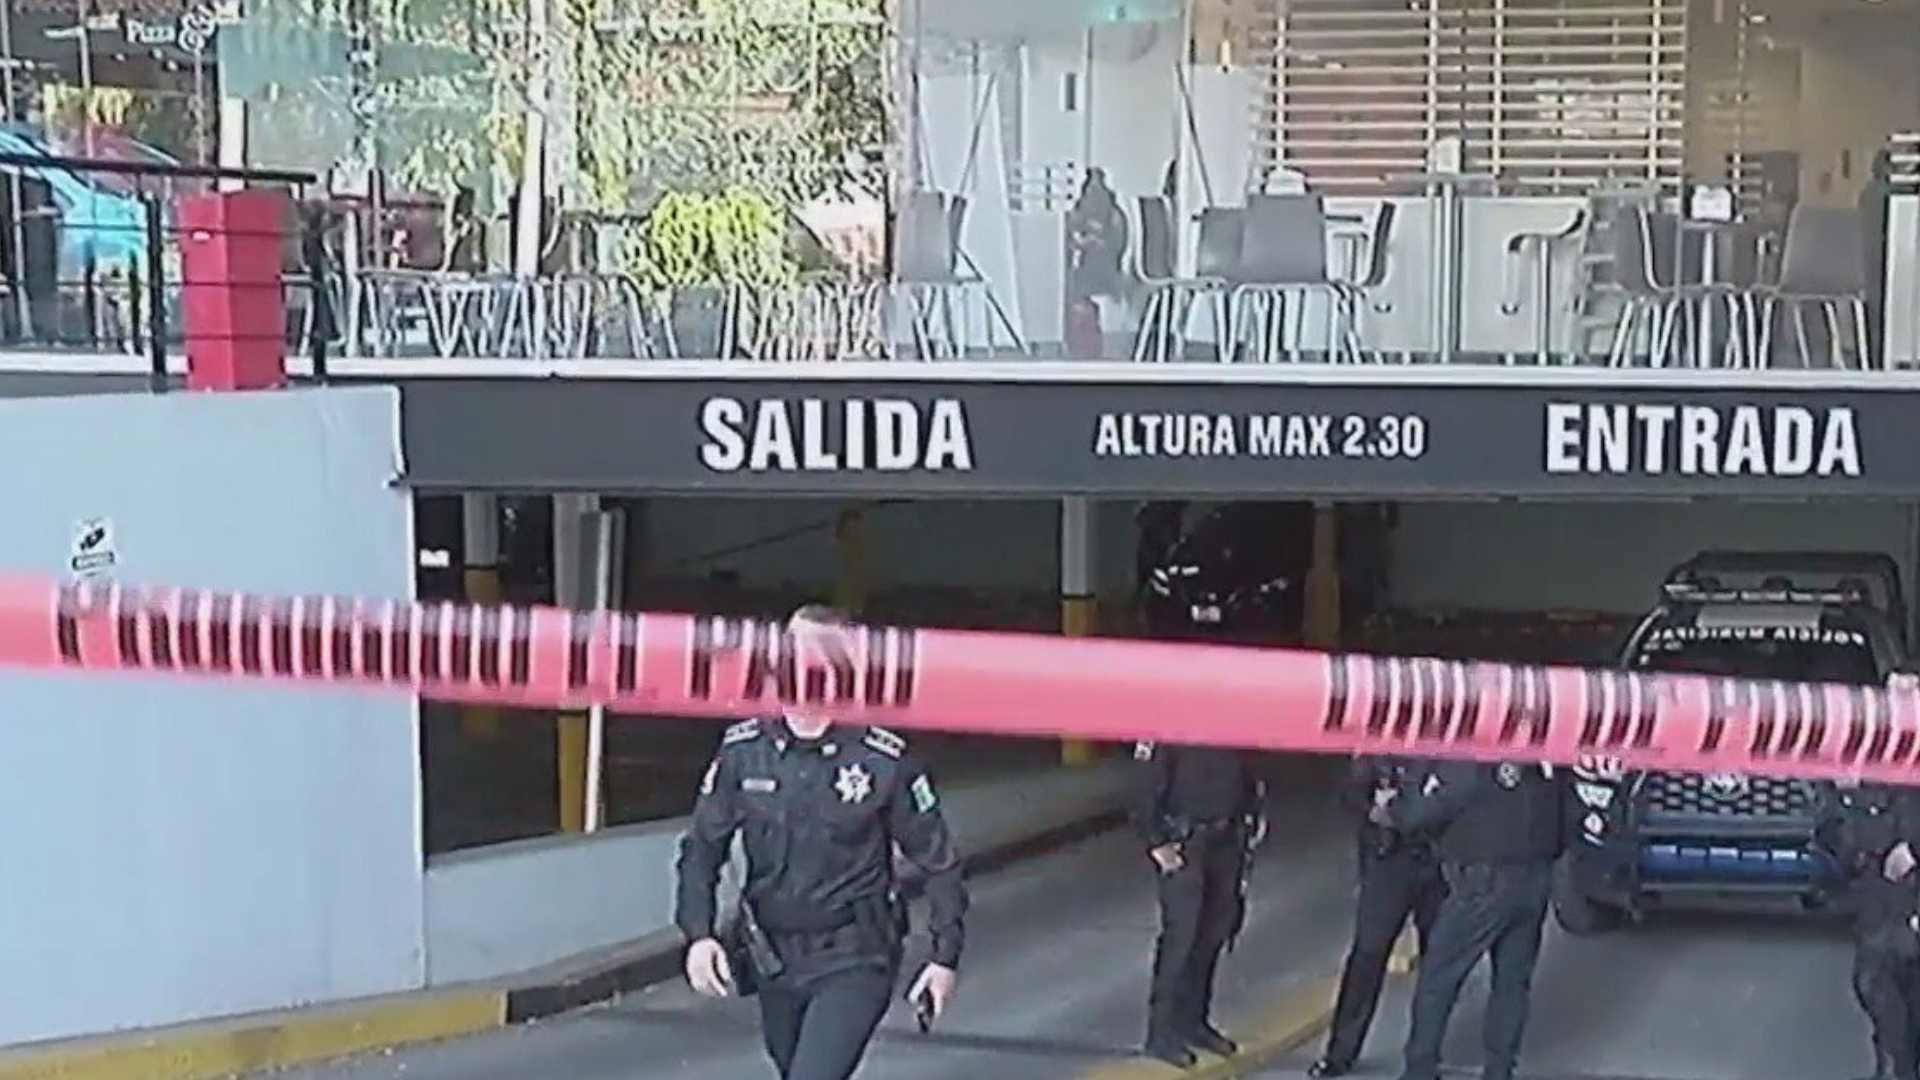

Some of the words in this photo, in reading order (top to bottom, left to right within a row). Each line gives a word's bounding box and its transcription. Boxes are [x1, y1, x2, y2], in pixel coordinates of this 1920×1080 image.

[700, 397, 972, 471] SALIDA
[1095, 414, 1237, 456] ALTURA
[1249, 415, 1331, 456] MAX
[1343, 415, 1425, 457] 2.30
[1547, 404, 1861, 476] ENTRADA
